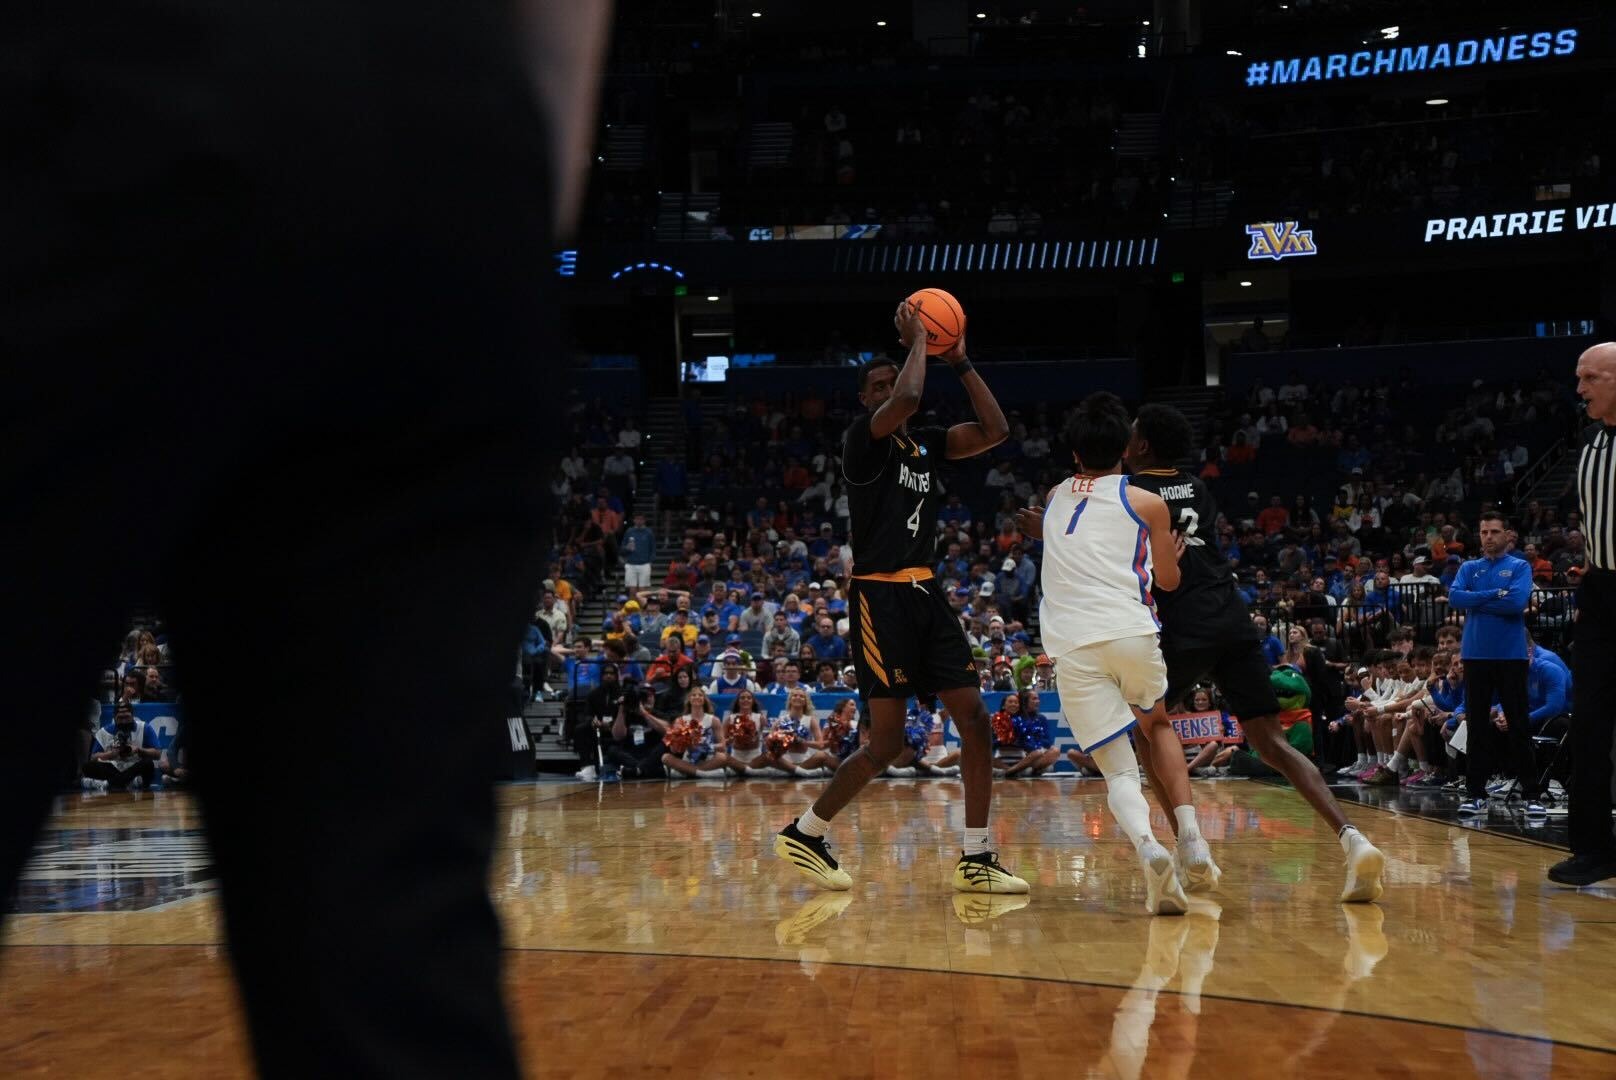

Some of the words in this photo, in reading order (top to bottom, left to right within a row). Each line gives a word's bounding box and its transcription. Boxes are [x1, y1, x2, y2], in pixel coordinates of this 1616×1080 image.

[1246, 29, 1578, 86] #MARCHMADNESS
[1424, 208, 1566, 242] PRAIRIE
[1071, 478, 1096, 493] LEE
[1159, 483, 1195, 500] HORNE
[907, 498, 925, 538] 4
[1065, 497, 1089, 535] 1
[1172, 716, 1220, 739] FENSE
